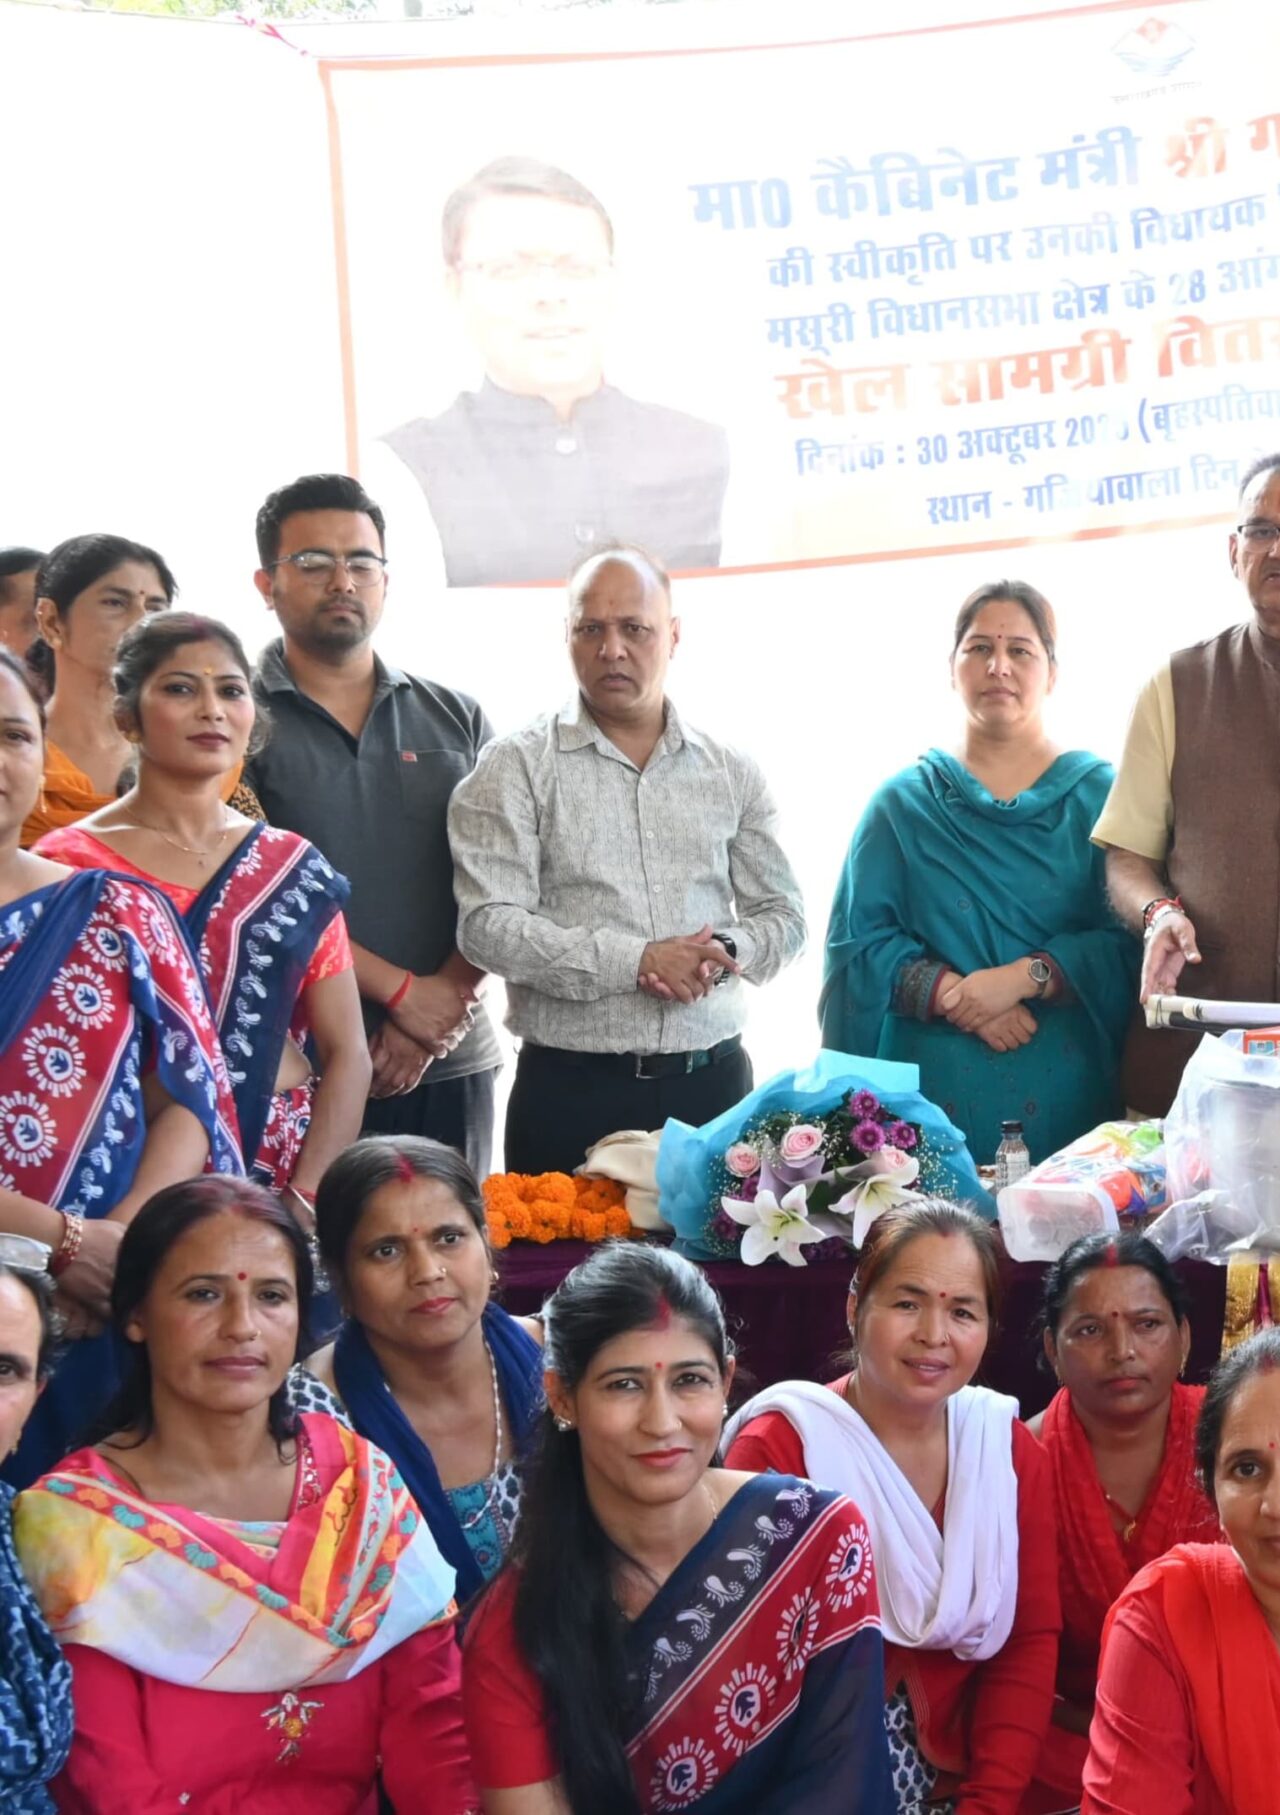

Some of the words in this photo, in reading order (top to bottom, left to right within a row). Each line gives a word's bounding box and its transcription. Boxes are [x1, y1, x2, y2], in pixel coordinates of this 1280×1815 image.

[810, 147, 1020, 219] कैबिनेट
[1036, 126, 1143, 189] मंत्री
[1165, 116, 1230, 178] श्री
[766, 246, 814, 287] की
[826, 232, 957, 286] स्वीकृति
[968, 231, 1013, 264] पर
[1022, 211, 1118, 259] उनकी
[1130, 194, 1267, 249] विधायक
[765, 302, 856, 356] मसूरी
[867, 291, 1040, 338] विधानसभा
[1052, 279, 1111, 320] क्षेत्र
[1120, 269, 1156, 310] के
[1169, 269, 1206, 305] 28
[774, 358, 911, 419] खेल
[929, 328, 1132, 406] सामग्री
[795, 434, 884, 476] दिनांक
[916, 434, 948, 465] 30
[957, 420, 1056, 465] अक्टूबर
[927, 491, 992, 525] स्थान
